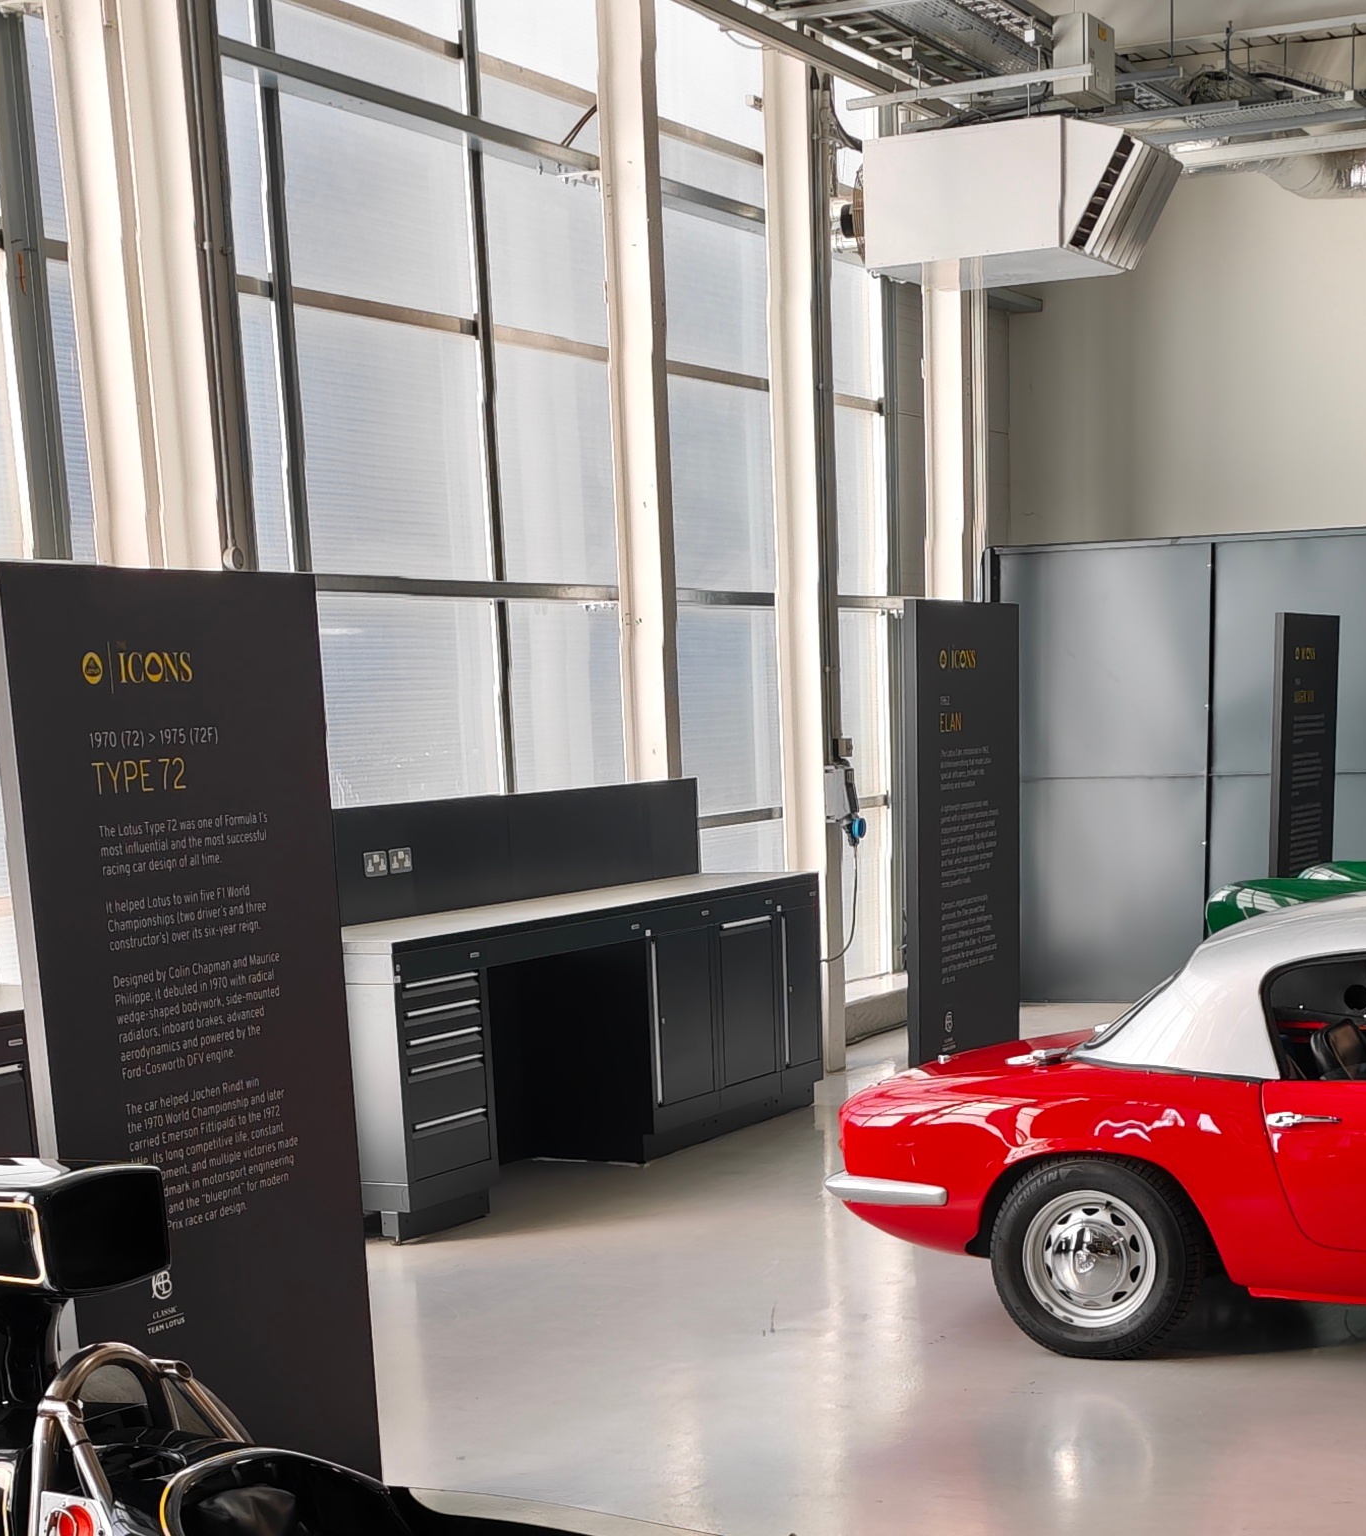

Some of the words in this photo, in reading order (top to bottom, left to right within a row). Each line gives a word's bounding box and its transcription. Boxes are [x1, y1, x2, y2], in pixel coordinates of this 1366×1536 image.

[118, 651, 193, 684] ICONS
[89, 730, 116, 748] 1970
[120, 729, 144, 748] (72)
[159, 727, 185, 744] 1975
[189, 726, 218, 745] (72F)
[939, 712, 962, 733] ELAN
[90, 759, 154, 794] TYPE
[157, 757, 186, 790] 72
[98, 825, 115, 837] The
[117, 823, 142, 836] Lotus
[143, 821, 165, 835] Type
[166, 818, 177, 831] 72
[179, 819, 195, 830] was
[197, 818, 212, 828] one
[214, 814, 222, 827] of
[224, 812, 257, 826] Formula
[100, 842, 123, 857] most
[125, 838, 168, 853] influential
[170, 836, 186, 849] and
[188, 835, 202, 848] the
[204, 832, 224, 846] most
[226, 828, 266, 844] successful
[102, 862, 130, 876] racing
[132, 861, 146, 872] car
[148, 858, 177, 871] design
[178, 854, 187, 867] of
[189, 853, 199, 866] all
[105, 901, 113, 913] It
[114, 897, 145, 913] helped
[146, 895, 170, 908] Lotus
[172, 893, 182, 904] to
[183, 891, 198, 903] win
[199, 889, 214, 901] five
[216, 887, 225, 899] F1
[226, 883, 250, 897] World
[107, 913, 174, 932] Championships
[228, 902, 244, 915] and
[245, 901, 266, 913] three
[171, 930, 189, 942] over
[192, 926, 202, 938] its
[204, 923, 236, 937] six-year
[112, 970, 154, 988] Designed
[155, 969, 166, 982] by
[168, 964, 190, 979] Colin
[192, 960, 230, 975] Chapman
[232, 955, 247, 968] and
[249, 952, 279, 965] Maurice
[154, 987, 161, 999] it
[163, 981, 197, 998] debuted
[209, 976, 227, 989] 1970
[229, 973, 246, 986] with
[248, 968, 274, 983] radical
[116, 1002, 180, 1024] wedge-shaped
[225, 985, 279, 1005] side-mounted
[161, 1018, 194, 1034] inboard
[226, 1004, 264, 1022] advanced
[120, 1041, 180, 1061] aerodynamics
[182, 1035, 198, 1049] and
[200, 1027, 234, 1048] powered
[247, 1024, 260, 1036] the
[121, 1056, 185, 1078] Ford-Cosworth
[186, 1051, 203, 1066] DFV
[125, 1103, 142, 1115] The
[144, 1100, 157, 1111] car
[159, 1091, 189, 1107] helped
[190, 1086, 220, 1101] Jochen
[221, 1079, 243, 1093] Rindt
[245, 1077, 259, 1088] win
[127, 1121, 142, 1133] the
[143, 1114, 163, 1129] 1970
[164, 1108, 189, 1124] World
[191, 1097, 248, 1118] Championship
[250, 1091, 265, 1105] and
[266, 1088, 284, 1101] later
[129, 1133, 159, 1152] carried
[161, 1126, 198, 1143] Emerson
[200, 1115, 236, 1134] Fittipaldi
[248, 1110, 261, 1123] the
[262, 1104, 280, 1119] 1972
[152, 1151, 163, 1163] Its
[164, 1148, 184, 1160] long
[185, 1135, 233, 1156] competitive
[250, 1121, 284, 1139] constant
[191, 1157, 206, 1172] and
[208, 1150, 241, 1167] multiple
[243, 1142, 276, 1158] victories
[277, 1135, 298, 1149] made
[201, 1164, 247, 1186] motorsport
[248, 1154, 294, 1174] engineering
[168, 1199, 184, 1214] and
[185, 1197, 199, 1209] the
[246, 1180, 257, 1191] for
[259, 1172, 288, 1188] modern
[184, 1213, 202, 1226] race
[204, 1209, 217, 1221] car
[147, 1324, 165, 1335] TEAM
[165, 1317, 186, 1329] LOTUS
